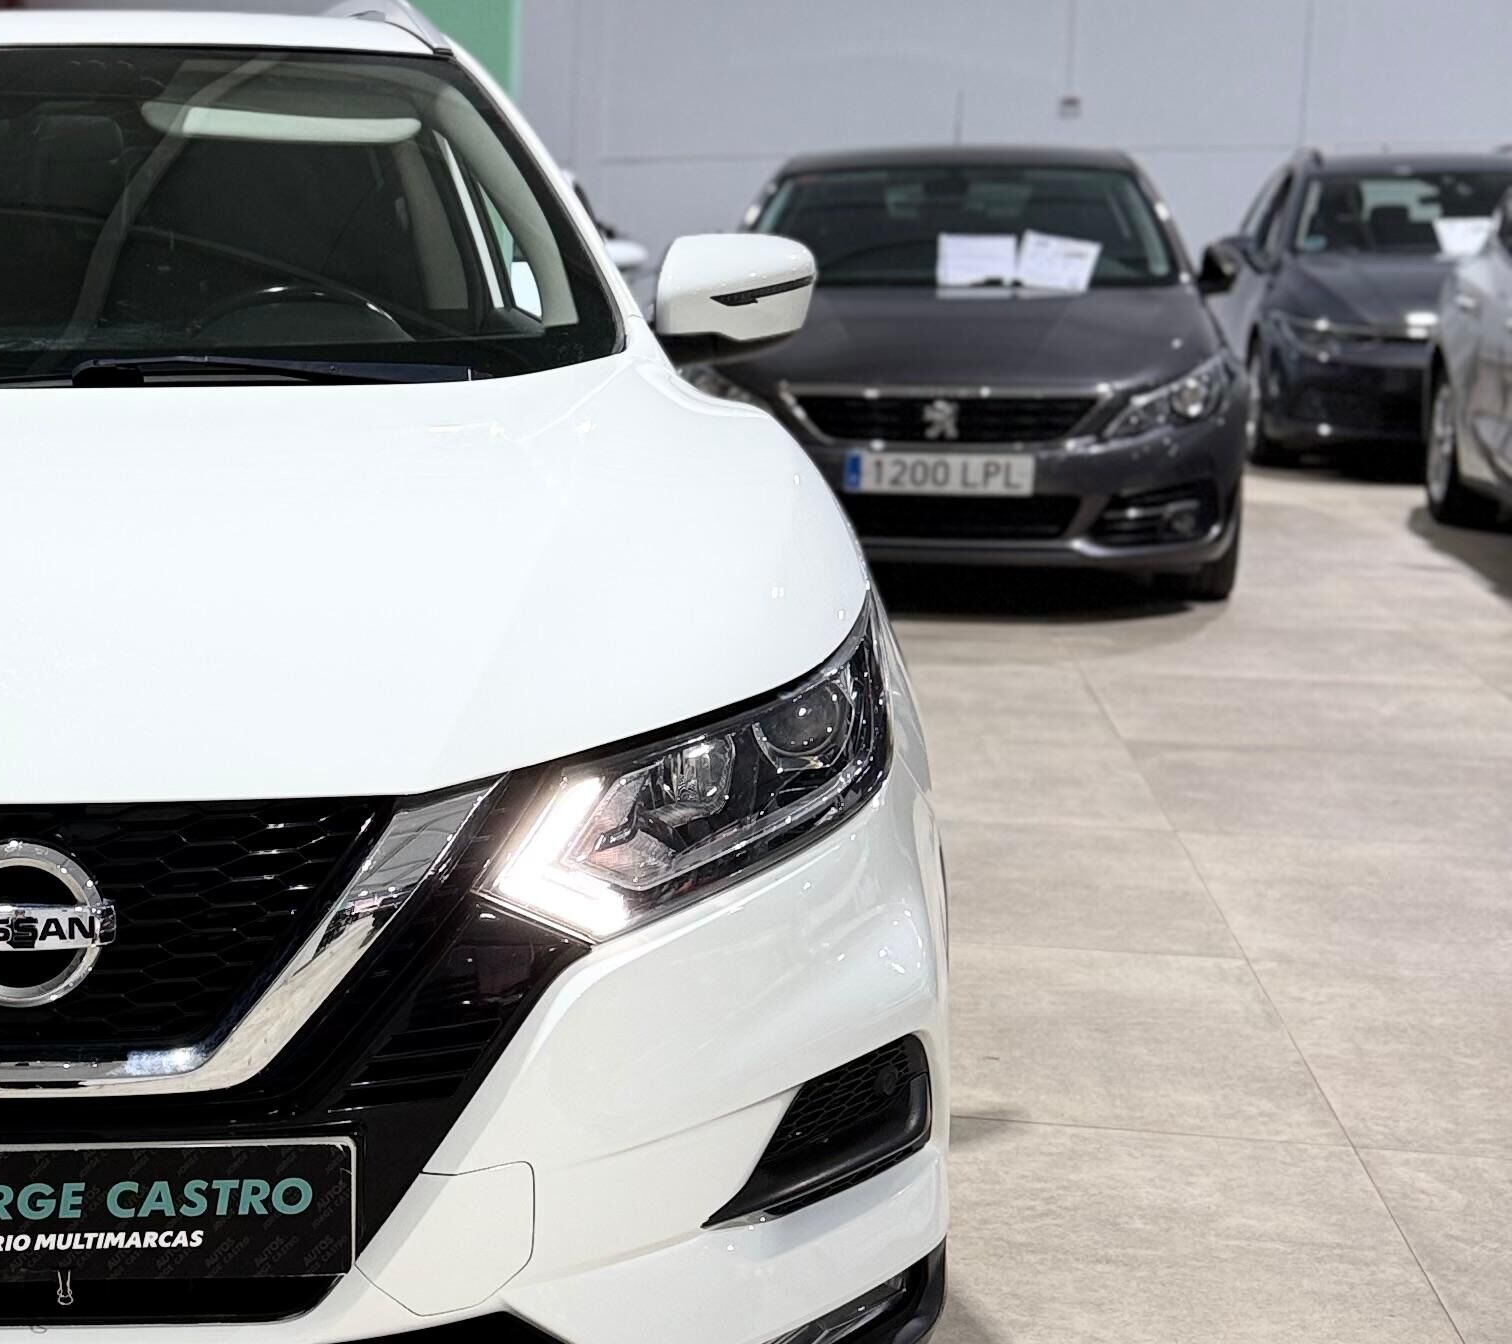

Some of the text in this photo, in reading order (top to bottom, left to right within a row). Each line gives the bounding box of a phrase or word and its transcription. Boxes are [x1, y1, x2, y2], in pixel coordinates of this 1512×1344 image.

[873, 459, 1023, 490] 1200 LPL
[107, 1177, 313, 1219] CASTRO
[34, 1229, 204, 1251] MULTIMARCAS
